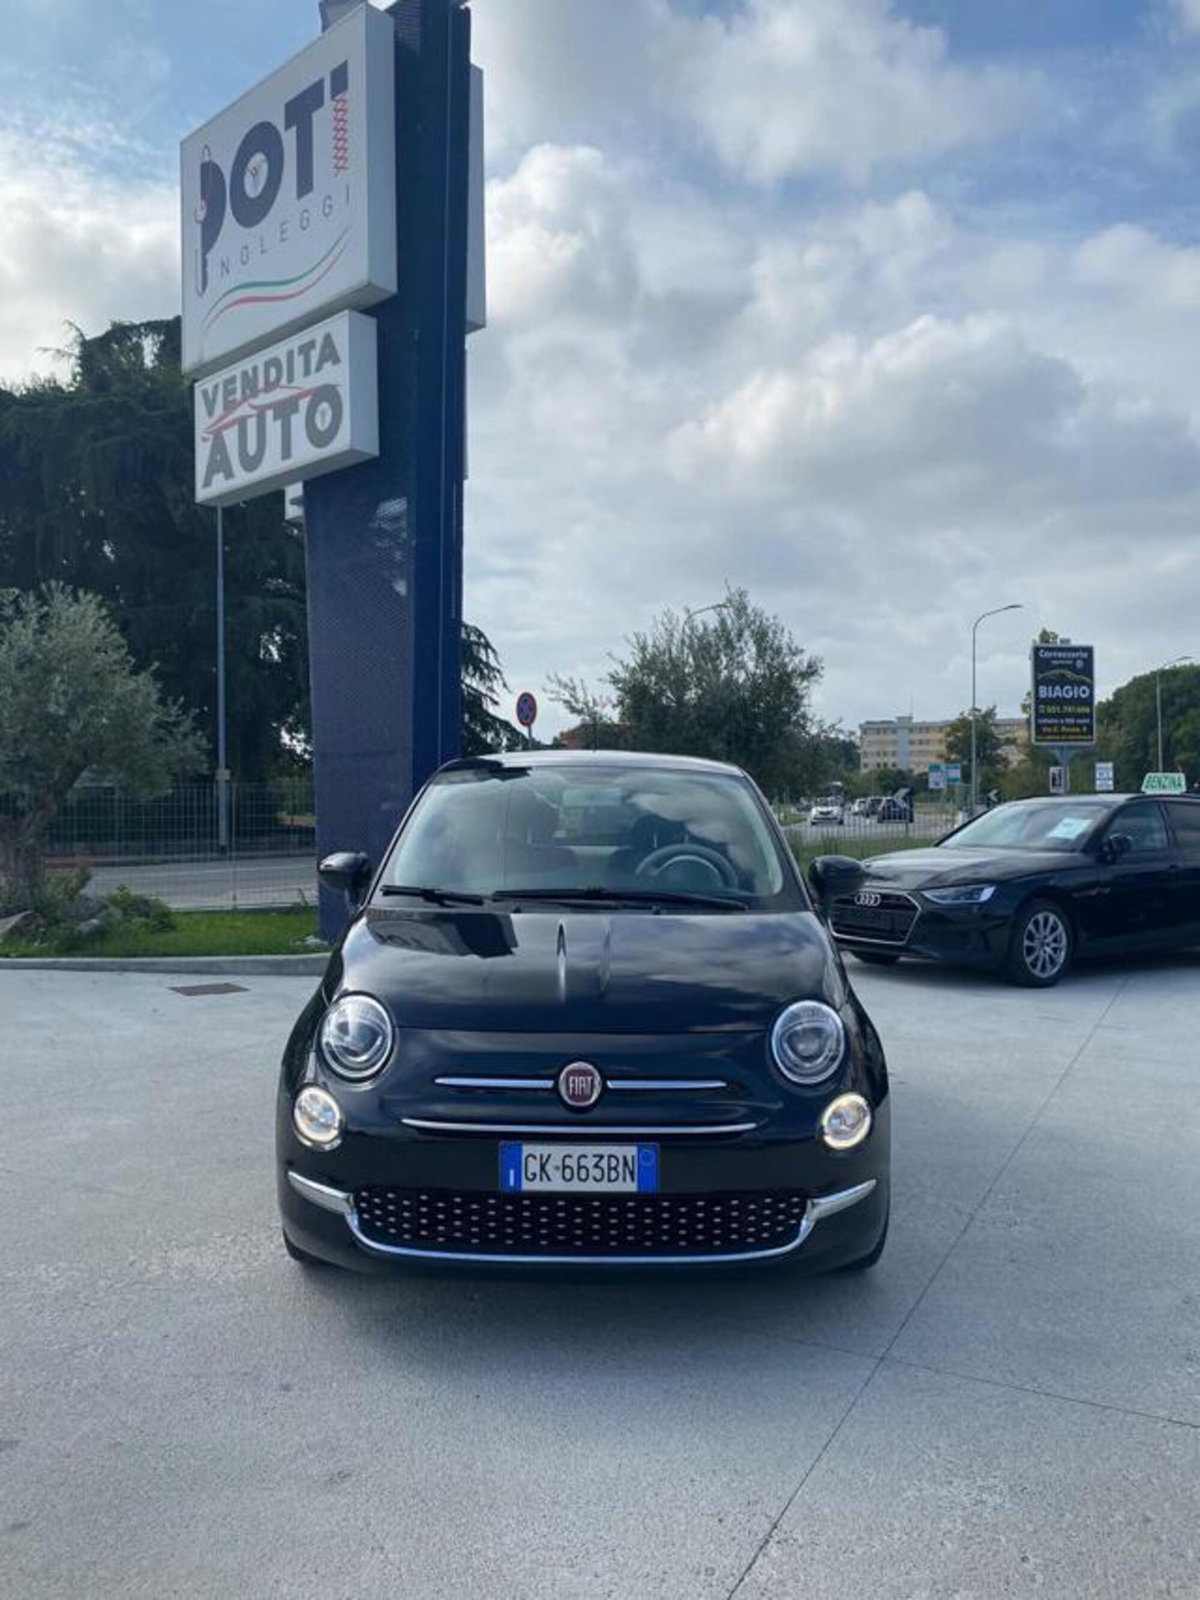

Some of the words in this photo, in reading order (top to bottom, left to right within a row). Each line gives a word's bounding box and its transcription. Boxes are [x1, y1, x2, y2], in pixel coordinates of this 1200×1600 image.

[220, 183, 350, 277] NOLEGGI
[202, 331, 342, 419] VENDITA
[202, 383, 343, 488] AUTO
[1038, 685, 1090, 699] BIAGIO
[568, 1075, 593, 1096] FIAT
